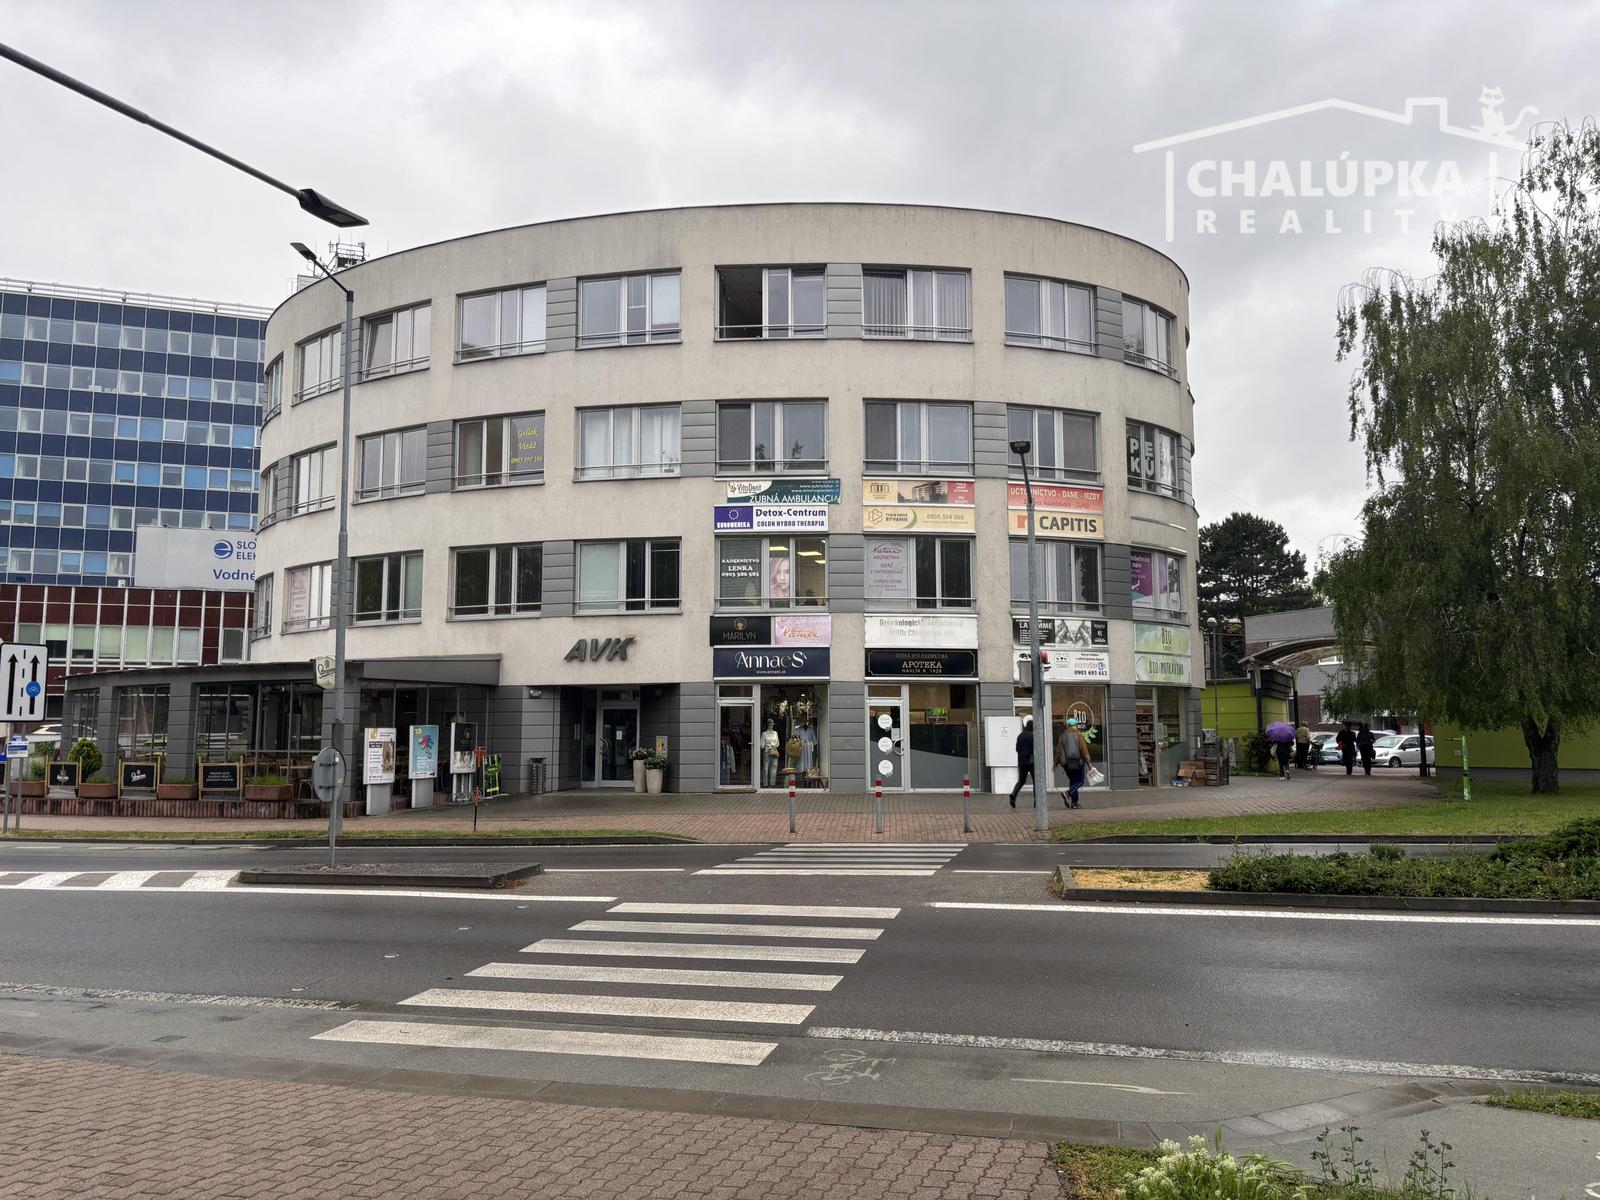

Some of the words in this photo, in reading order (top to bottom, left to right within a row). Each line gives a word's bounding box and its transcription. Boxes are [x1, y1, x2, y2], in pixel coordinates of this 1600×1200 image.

[737, 483, 762, 492] VitaDent
[749, 492, 780, 504] ZUBNÁ
[781, 494, 840, 504] AMBULANCIA
[1062, 490, 1079, 499] DANE
[1084, 492, 1101, 500] MZDY
[755, 508, 827, 517] Detox-Centrum
[1039, 515, 1097, 533] CAPITIS
[212, 569, 256, 581] Vodné
[722, 631, 757, 641] MARILYN
[1161, 628, 1172, 645] BIO
[563, 636, 637, 662] AVK
[1148, 660, 1159, 674] BIO
[1160, 661, 1184, 676] POTRAVINY
